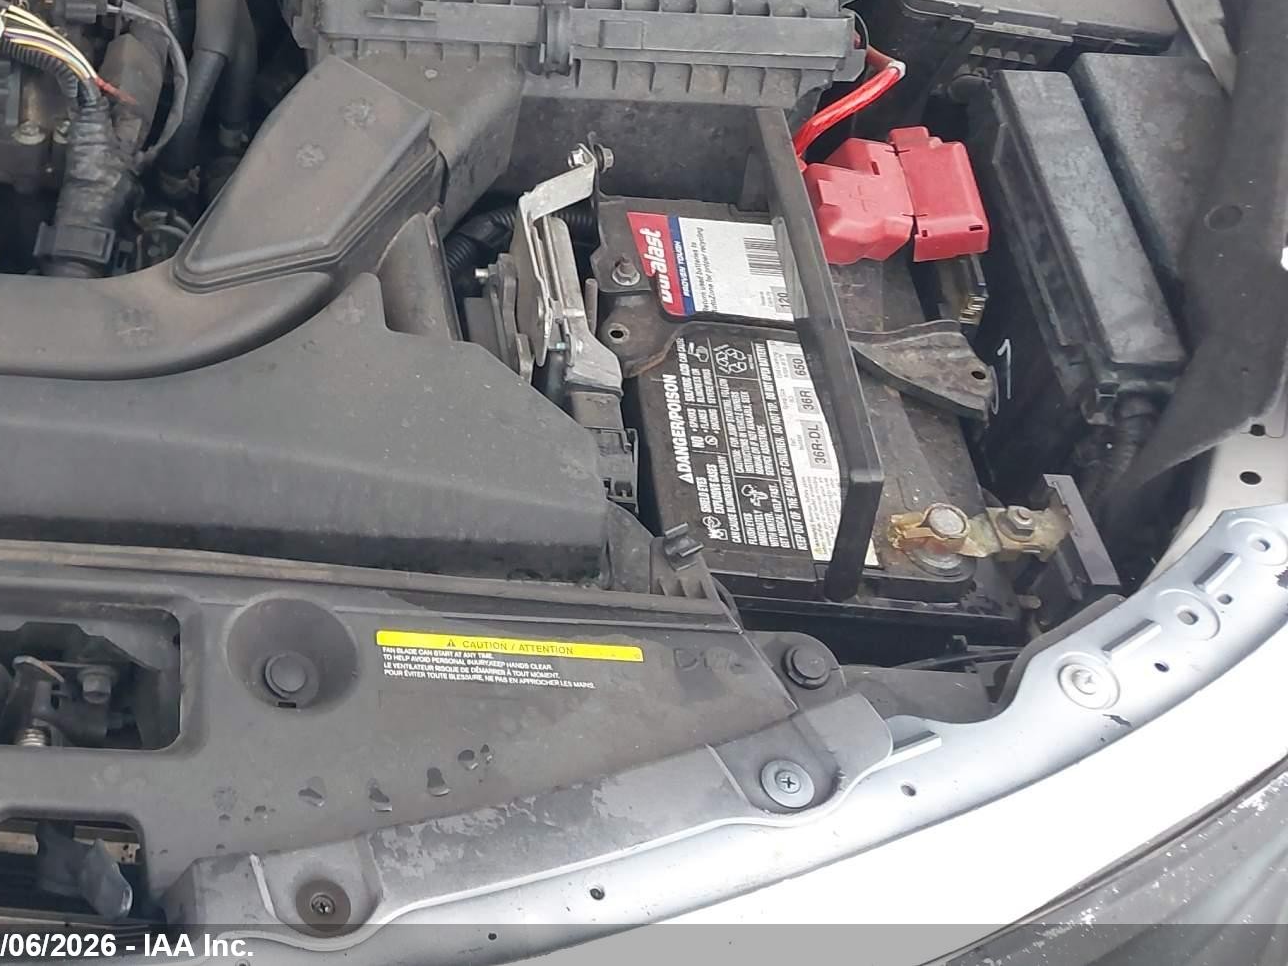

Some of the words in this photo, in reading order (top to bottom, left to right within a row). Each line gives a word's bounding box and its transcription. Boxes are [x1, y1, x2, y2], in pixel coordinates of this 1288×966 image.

[696, 227, 706, 252] recycling
[674, 240, 684, 265] TOUGH
[777, 293, 790, 307] 120
[678, 353, 687, 362] CAN
[679, 363, 690, 375] ACID
[760, 367, 771, 380] OPEN
[792, 358, 806, 375] 650
[682, 377, 695, 401] SULFURIC
[763, 381, 773, 391] NOT
[705, 385, 716, 403] SEVERE
[799, 390, 813, 409] 36R
[661, 374, 692, 472] DANGER/POISON
[687, 408, 698, 427] SPARKS
[698, 409, 709, 428] FLAMES
[709, 409, 720, 429] SMOKING
[770, 412, 780, 424] NOT
[772, 424, 782, 432] DO
[691, 436, 704, 447] NO
[729, 437, 739, 447] FOR
[807, 424, 826, 463] 36R-DL
[717, 455, 729, 474] INJURY
[706, 464, 719, 482] GASES
[695, 476, 708, 491] EYES
[783, 476, 795, 496] REACH
[698, 492, 711, 512] SHIELD
[709, 482, 725, 513] EXPLOSIVE
[772, 499, 782, 511] HELP
[787, 497, 798, 508] THE
[727, 514, 739, 530] CAUSE
[743, 512, 753, 525] EYES
[790, 511, 800, 519] OF
[753, 509, 768, 545] IMMEDIATELY
[775, 513, 787, 536] MEDICAL
[792, 520, 803, 533] OUT
[731, 531, 741, 542] CAN
[746, 527, 757, 544] FLUSH
[768, 532, 779, 546] WITH
[779, 537, 789, 547] GET
[795, 534, 807, 550] KEEP
[382, 646, 396, 654] FAN
[396, 647, 417, 655] BLADE
[418, 648, 432, 656] CAN
[434, 649, 453, 657] START
[462, 640, 508, 650] CAUTION
[518, 643, 574, 654] ATTENTION
[394, 654, 410, 662] HELP
[411, 655, 430, 663] AVOID
[432, 656, 465, 665] PERSONAL
[393, 662, 433, 672] VENTILATEUR
[435, 665, 459, 673] RISQUE
[460, 666, 469, 674] DE
[427, 671, 448, 679] TOUTE
[520, 678, 560, 686] APPROCHER
